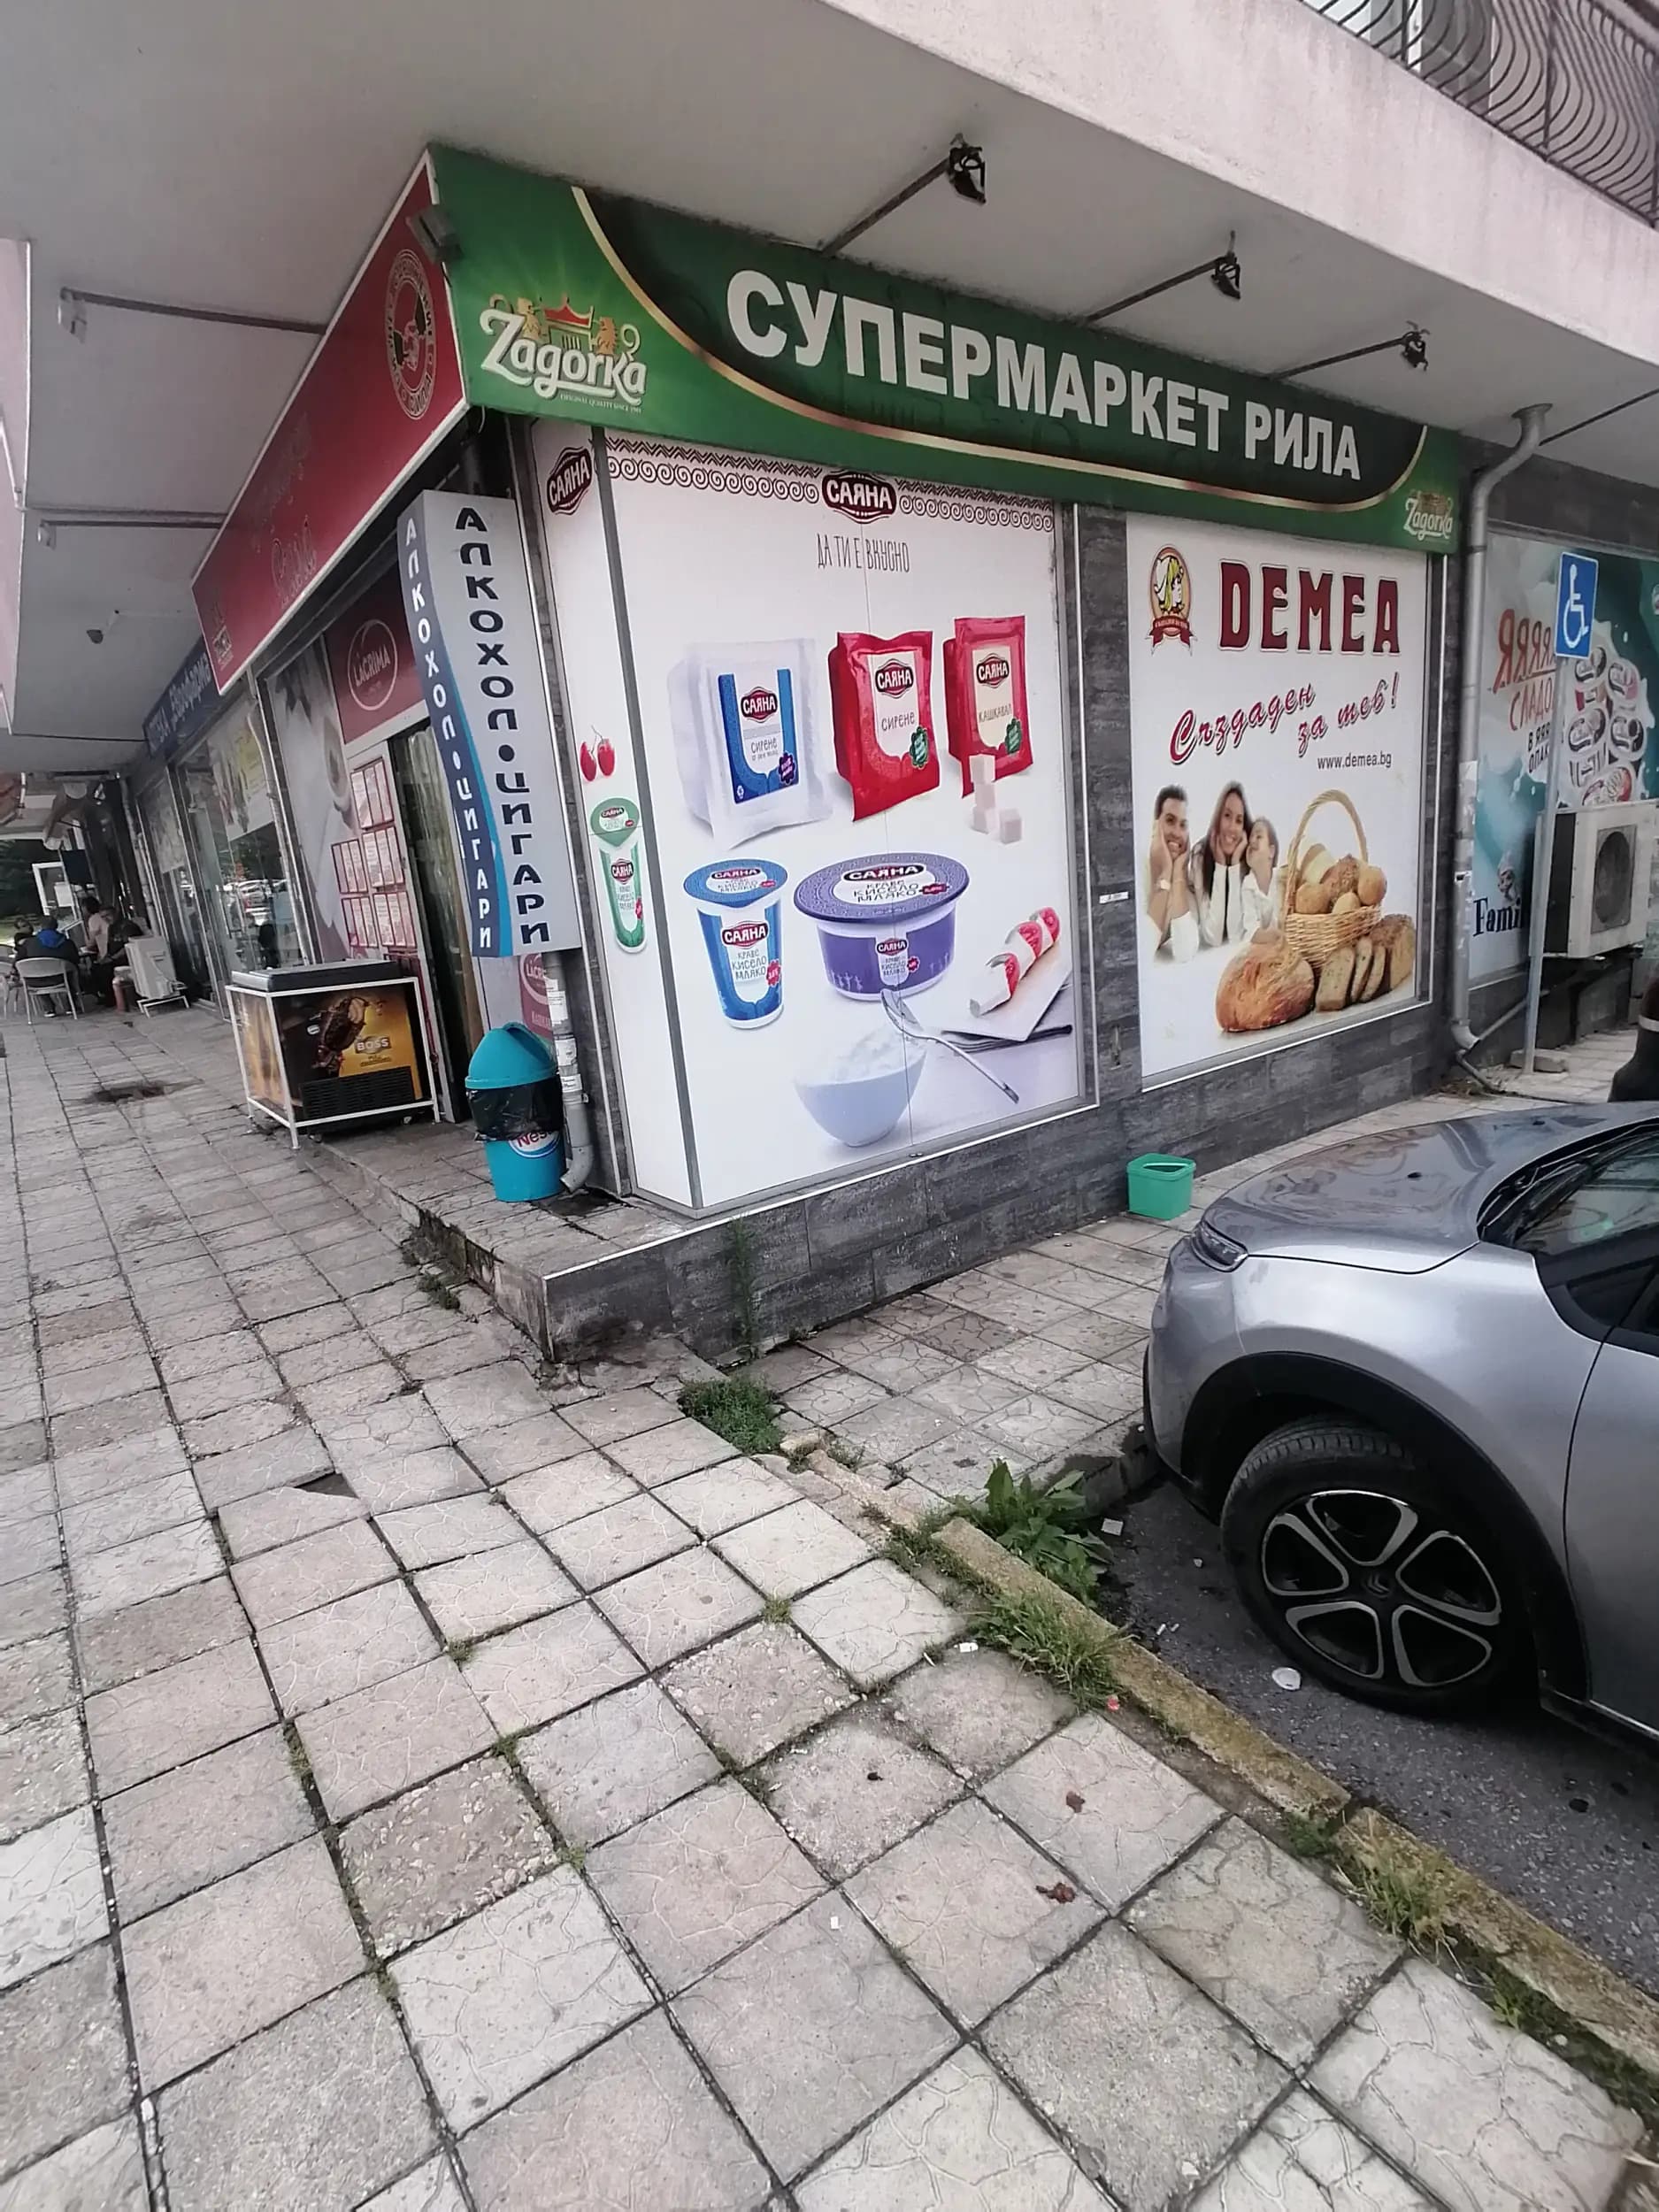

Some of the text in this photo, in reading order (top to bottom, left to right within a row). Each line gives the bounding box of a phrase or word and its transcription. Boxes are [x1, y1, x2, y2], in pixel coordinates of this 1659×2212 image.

[480, 309, 647, 406] Zagorka
[726, 269, 1361, 480] СУПЕРМАРКЕТ РИЛА
[549, 456, 590, 506] САЯНА
[826, 479, 893, 510] САЯНА
[1403, 496, 1453, 541] Zagorka
[817, 533, 833, 569] ДА
[833, 535, 851, 569] ТИ
[1218, 562, 1401, 655] DEMEA
[353, 643, 391, 687] LACRIMA
[1493, 608, 1555, 695] ЯЯЯЯ
[877, 669, 912, 690] САЯНА
[978, 662, 1008, 681] САЯНА
[743, 695, 776, 714] САЯНА
[1509, 677, 1555, 732] СЛАДО
[881, 711, 916, 732] СИРЕНЕ
[1297, 714, 1329, 758] за
[1317, 750, 1392, 770] www.demea.bg
[714, 869, 758, 879] САЯНА
[849, 865, 918, 880] САЯНА
[854, 883, 919, 897] КИСЕЛО
[857, 888, 917, 902] МЛЯКО
[1472, 896, 1522, 937] Fami
[725, 926, 766, 943] САЯНА
[357, 1038, 390, 1051] BOSS
